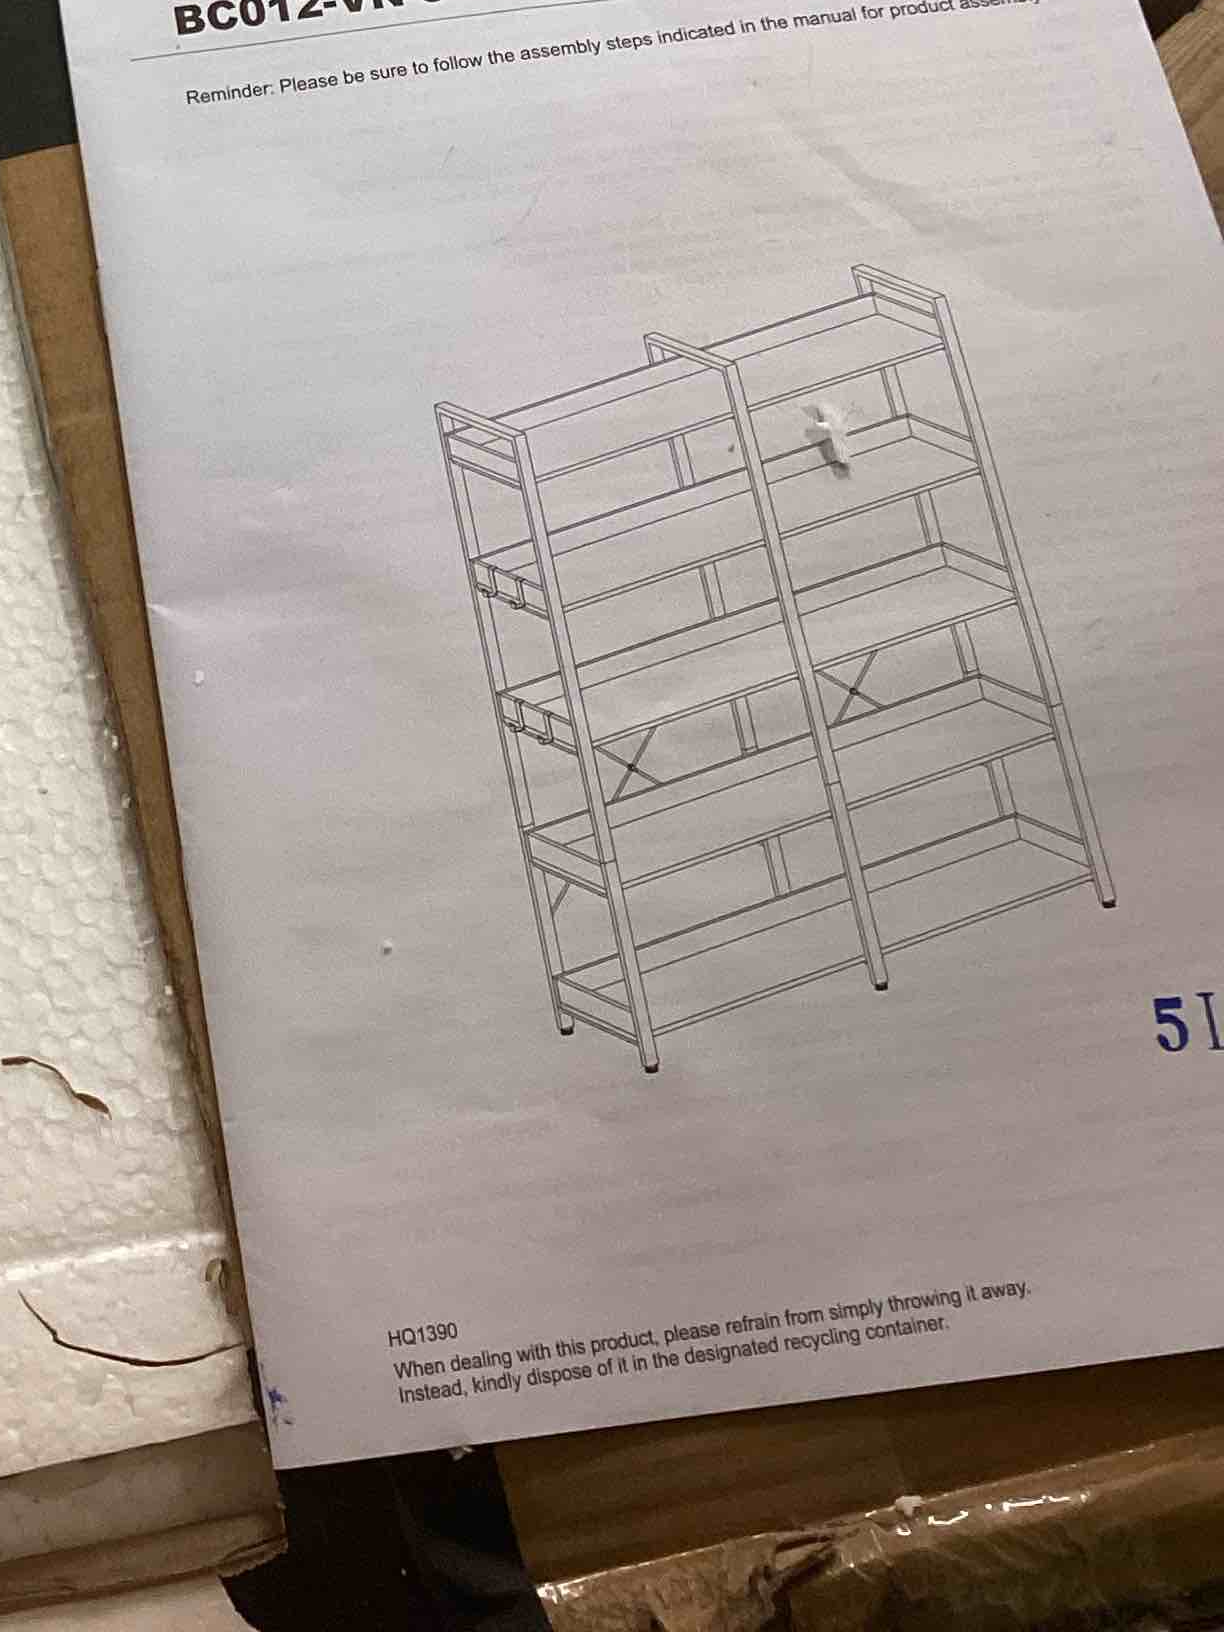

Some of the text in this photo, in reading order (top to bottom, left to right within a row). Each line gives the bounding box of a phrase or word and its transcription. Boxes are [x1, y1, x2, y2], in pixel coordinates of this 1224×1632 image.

[186, 81, 275, 106] Reminder:
[279, 72, 338, 96] Please
[343, 66, 366, 86] be
[370, 63, 408, 82] sure
[412, 59, 430, 76] to
[433, 51, 484, 74] follow
[488, 46, 516, 66] the
[520, 37, 602, 63] assembly
[606, 32, 653, 53] steps
[657, 18, 736, 45] indicated
[740, 17, 757, 35] in
[760, 13, 790, 33] the
[793, 7, 857, 30] manual
[861, 4, 885, 22] for
[388, 1321, 459, 1348] HQ1390
[394, 1279, 1032, 1380] When dealing with this product, please refrain from simply throwing it away.
[399, 1315, 950, 1404] Instead, kindly dispose of it in the designated recycling container.
